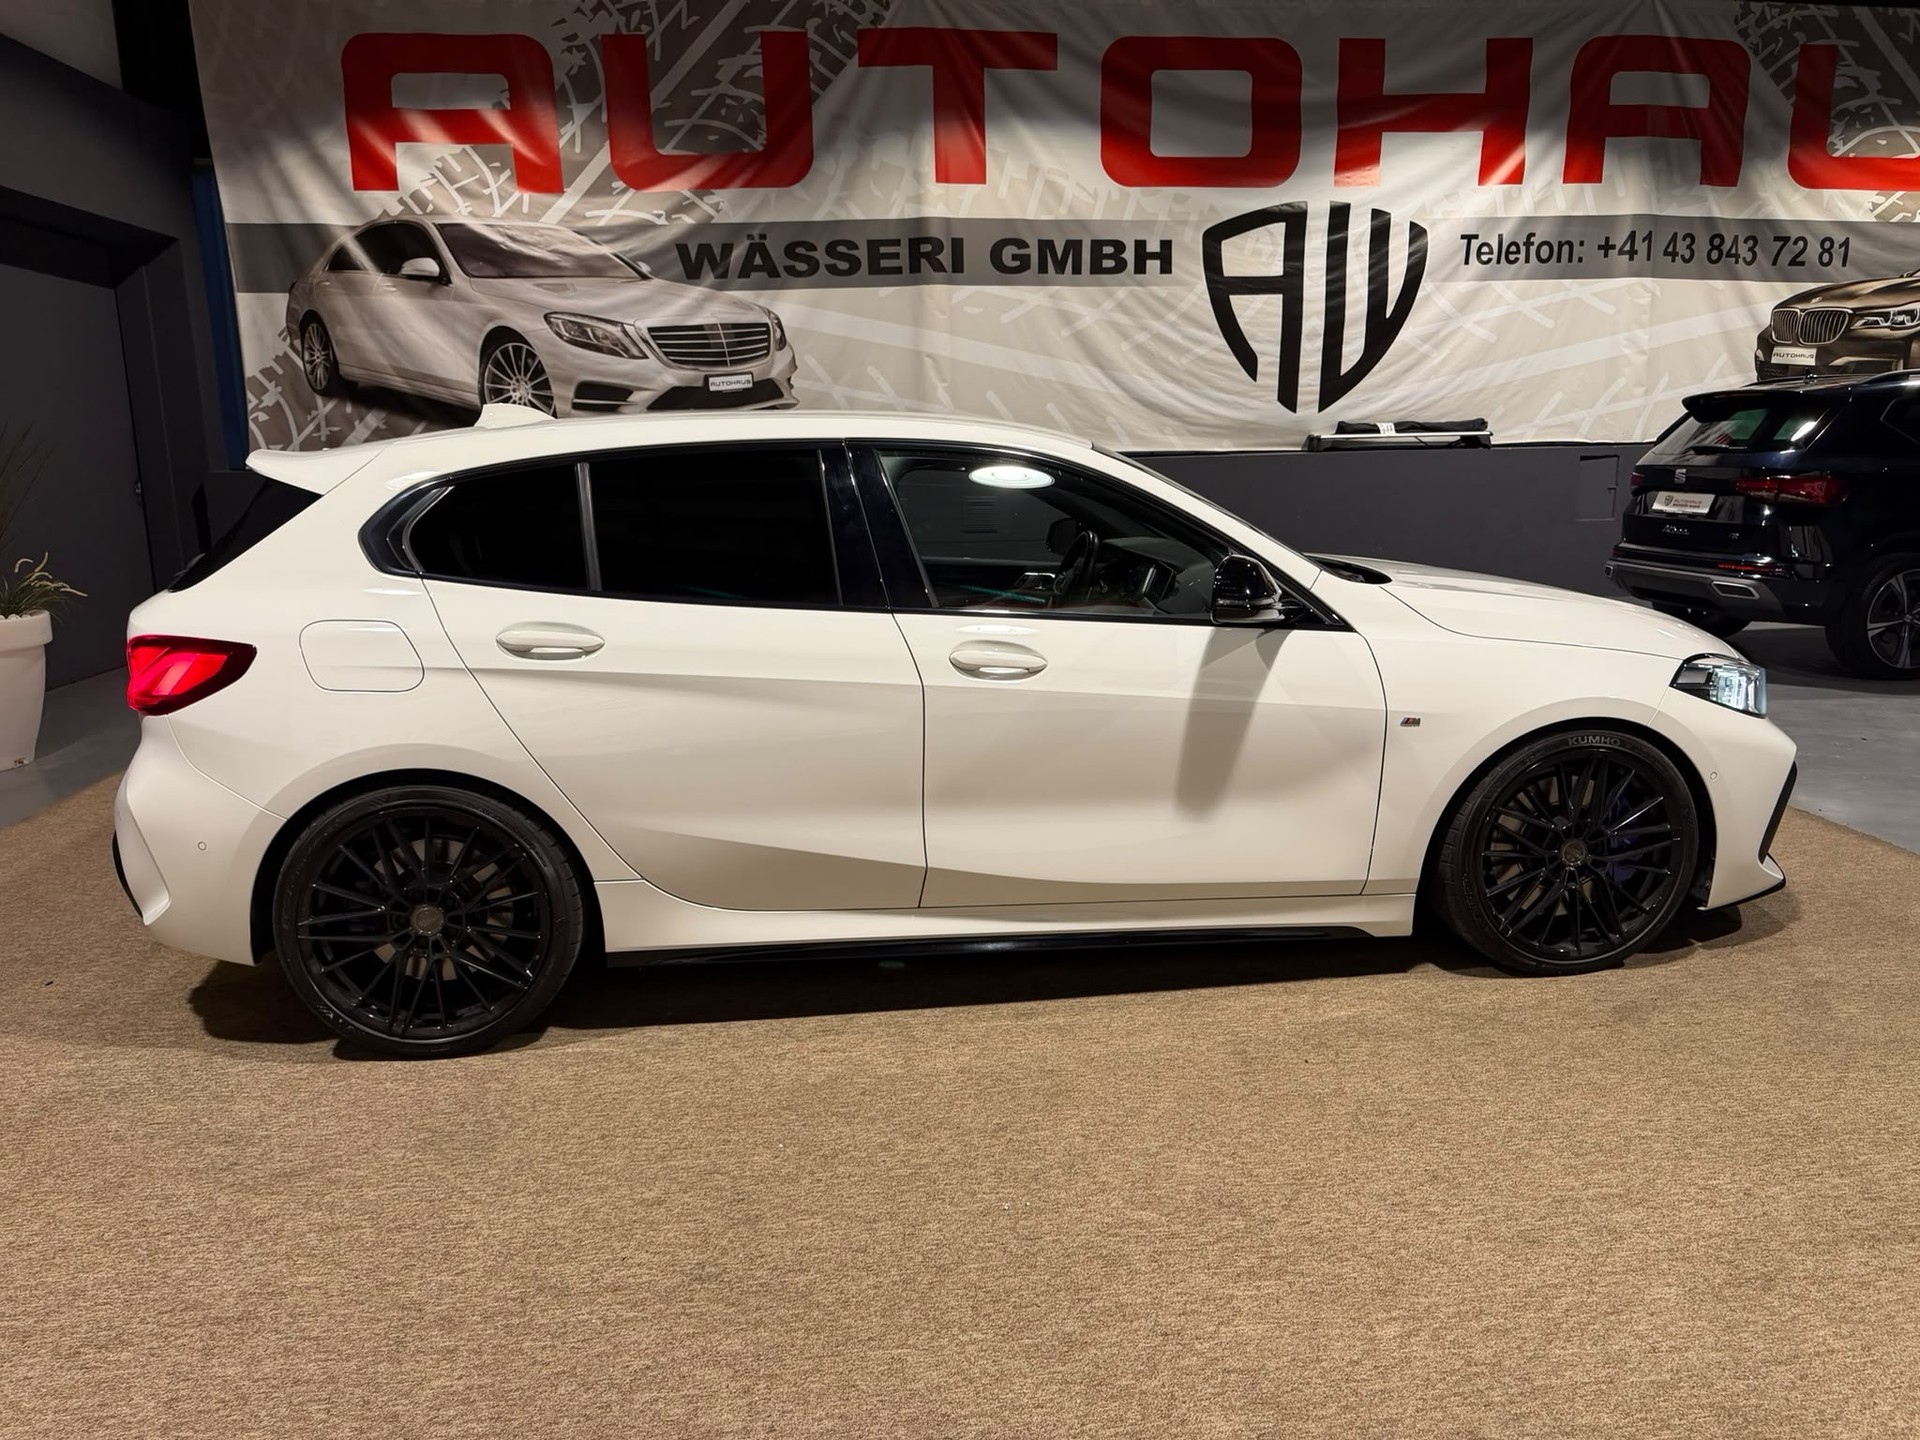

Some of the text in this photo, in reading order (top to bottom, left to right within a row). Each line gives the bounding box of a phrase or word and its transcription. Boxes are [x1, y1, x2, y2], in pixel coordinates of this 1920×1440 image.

[675, 233, 1173, 280] WÄSSERI GMBH
[1460, 230, 1851, 268] Telefon: +41 43 843 72 81
[710, 379, 752, 387] AUTOHAUS
[1567, 735, 1621, 746] KUMHO
